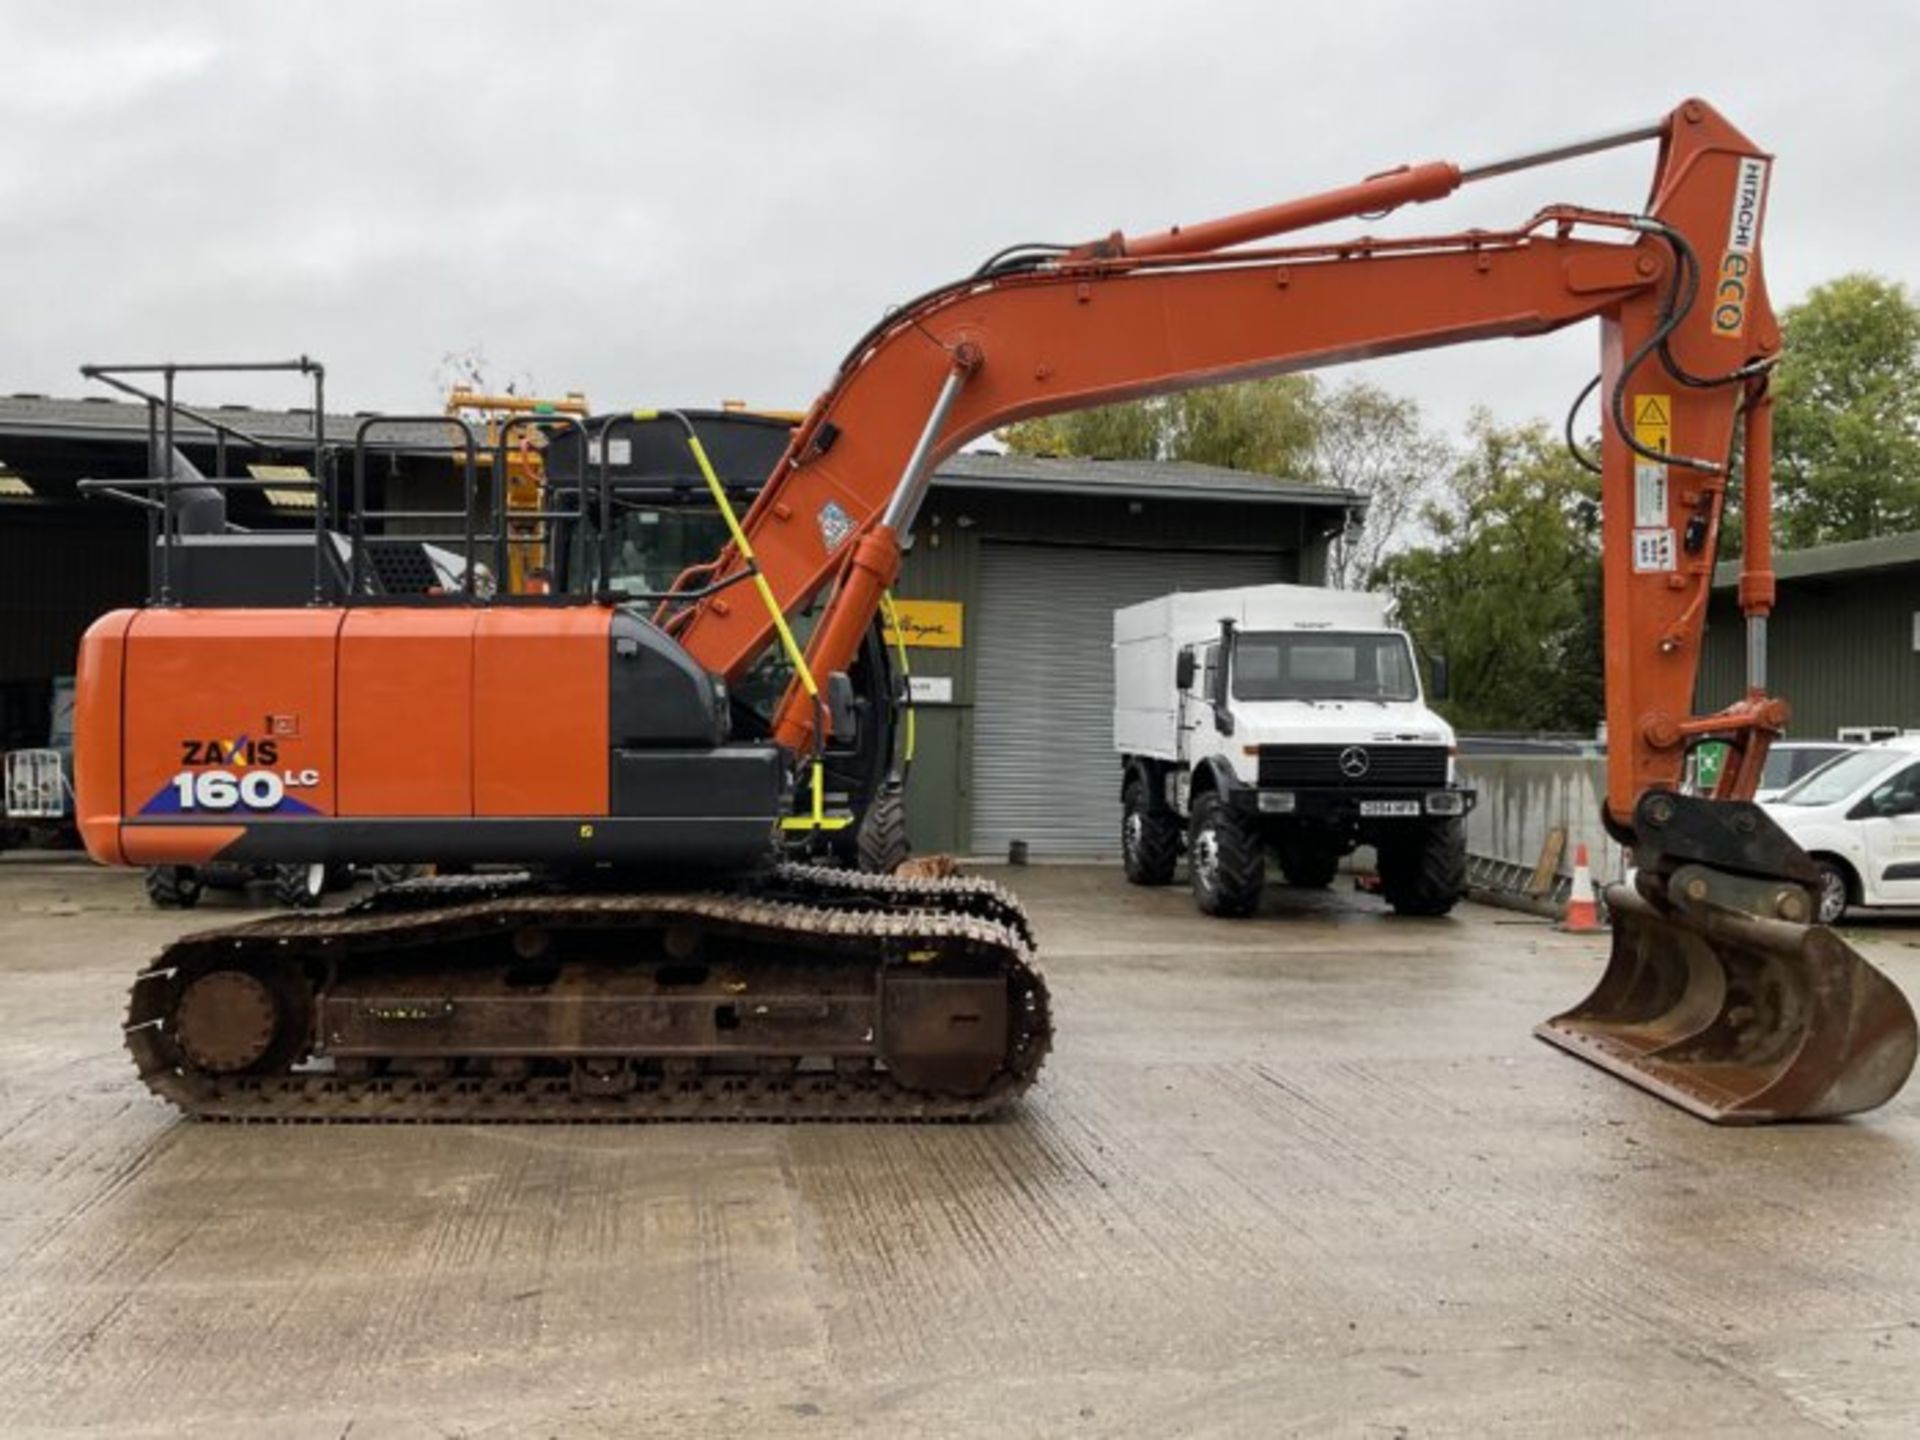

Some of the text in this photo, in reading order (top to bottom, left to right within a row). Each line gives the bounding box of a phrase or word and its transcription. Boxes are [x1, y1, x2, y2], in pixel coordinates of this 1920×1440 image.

[1715, 163, 1760, 331] HITACHI eco
[181, 735, 278, 767] ZAXIS
[172, 769, 320, 810] 160 LC
